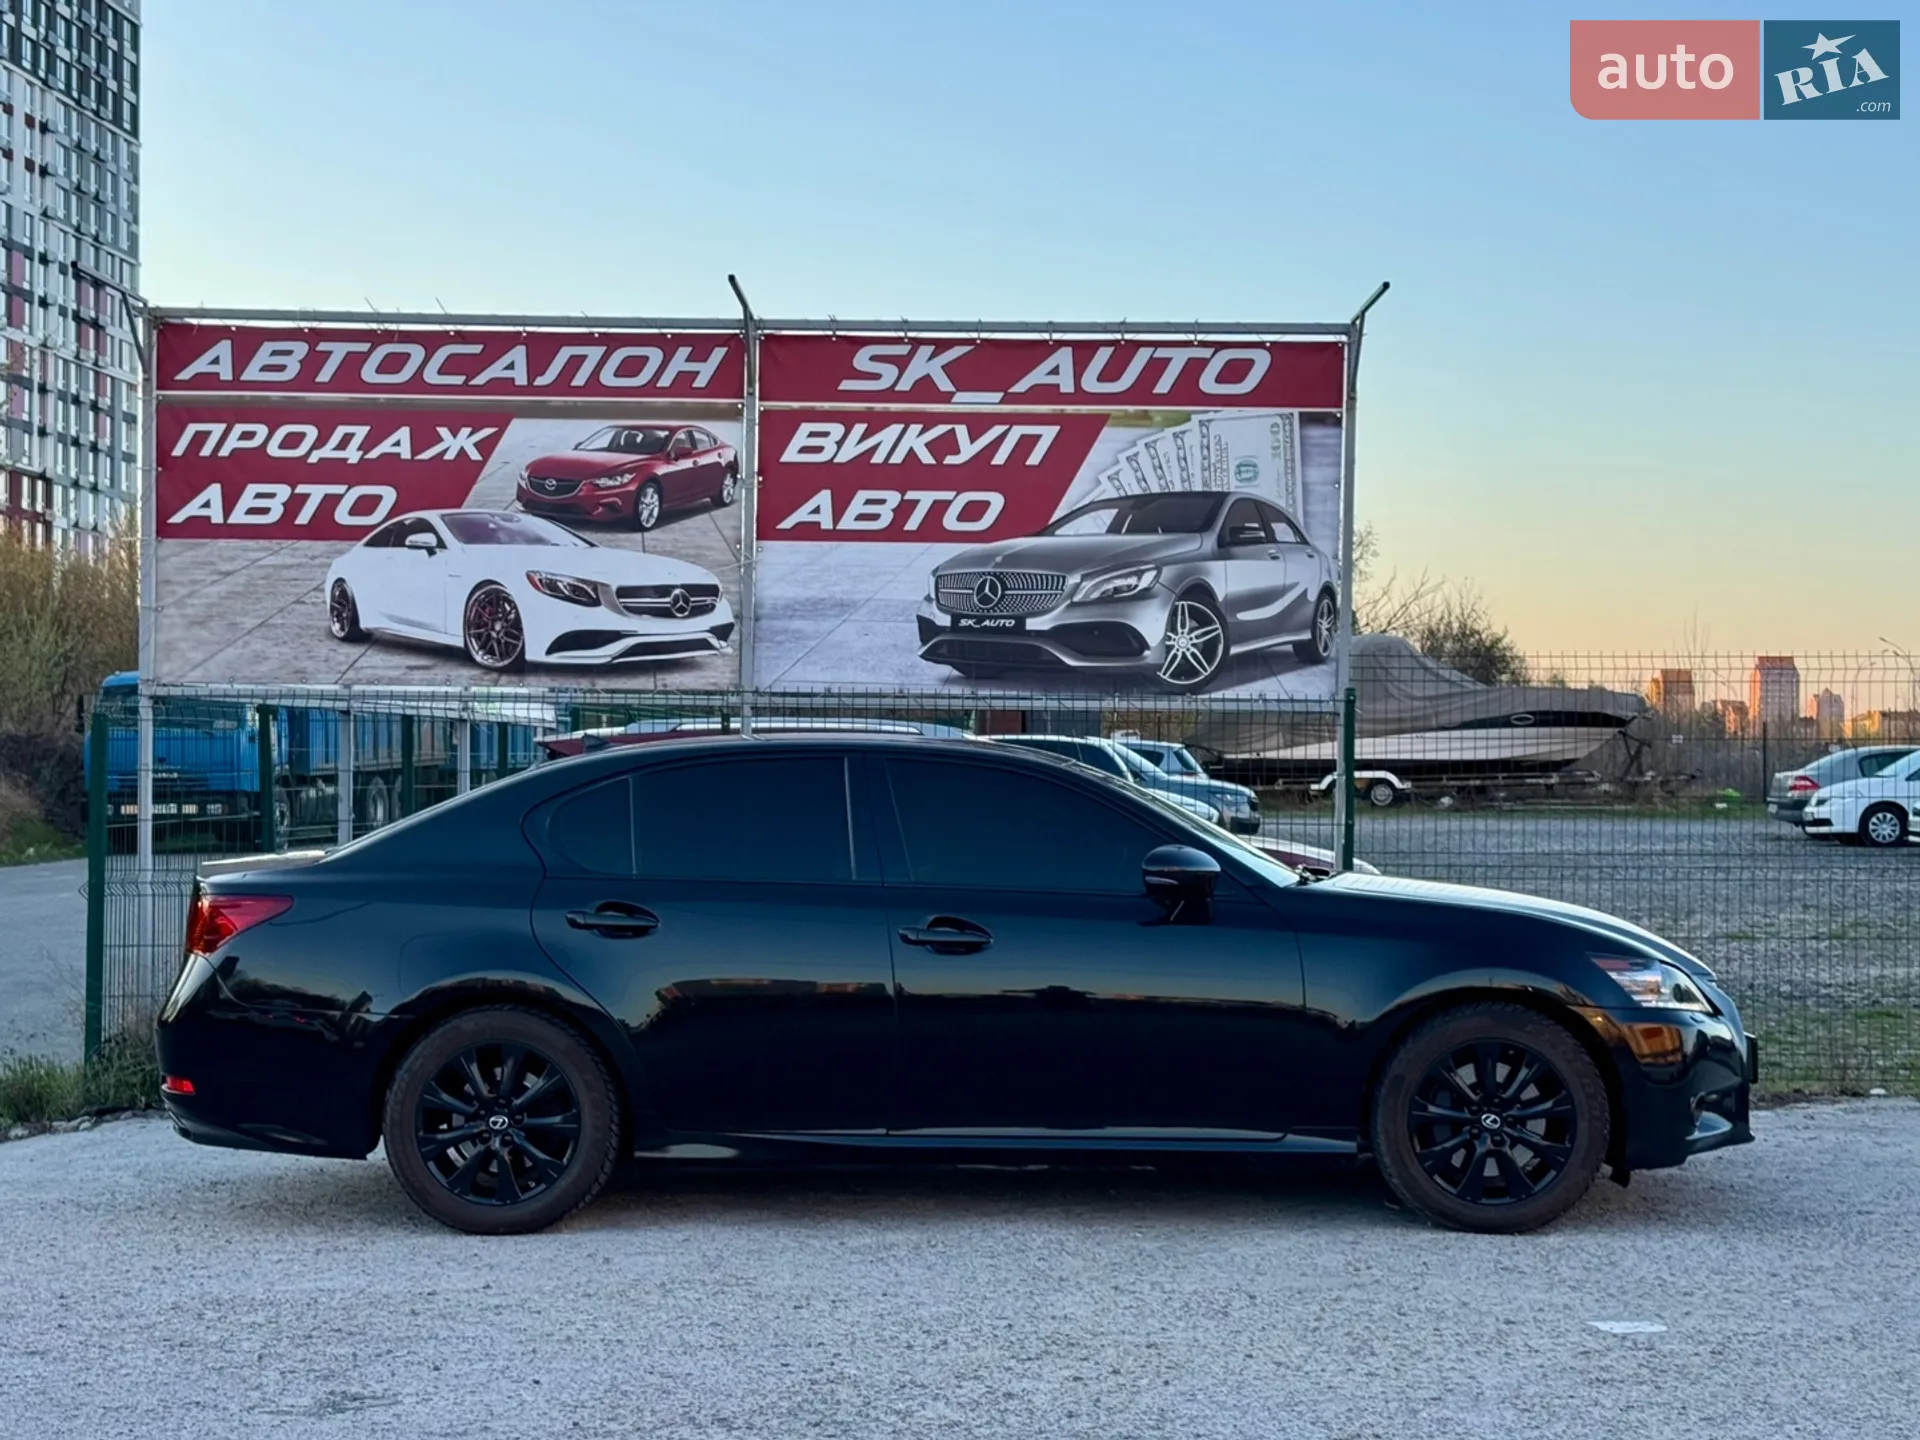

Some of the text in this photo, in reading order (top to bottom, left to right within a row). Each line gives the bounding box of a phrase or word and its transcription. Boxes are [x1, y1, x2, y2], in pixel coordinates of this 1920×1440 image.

[174, 340, 728, 388] АВТОСАЛОН
[837, 344, 1271, 404] SK_AUTO
[171, 422, 499, 464] ПРОДАЖ
[779, 422, 1061, 466] ВИКУП
[166, 483, 397, 526] АВТО
[776, 489, 1005, 532] АВТО
[958, 618, 1016, 628] SK_AUTO
